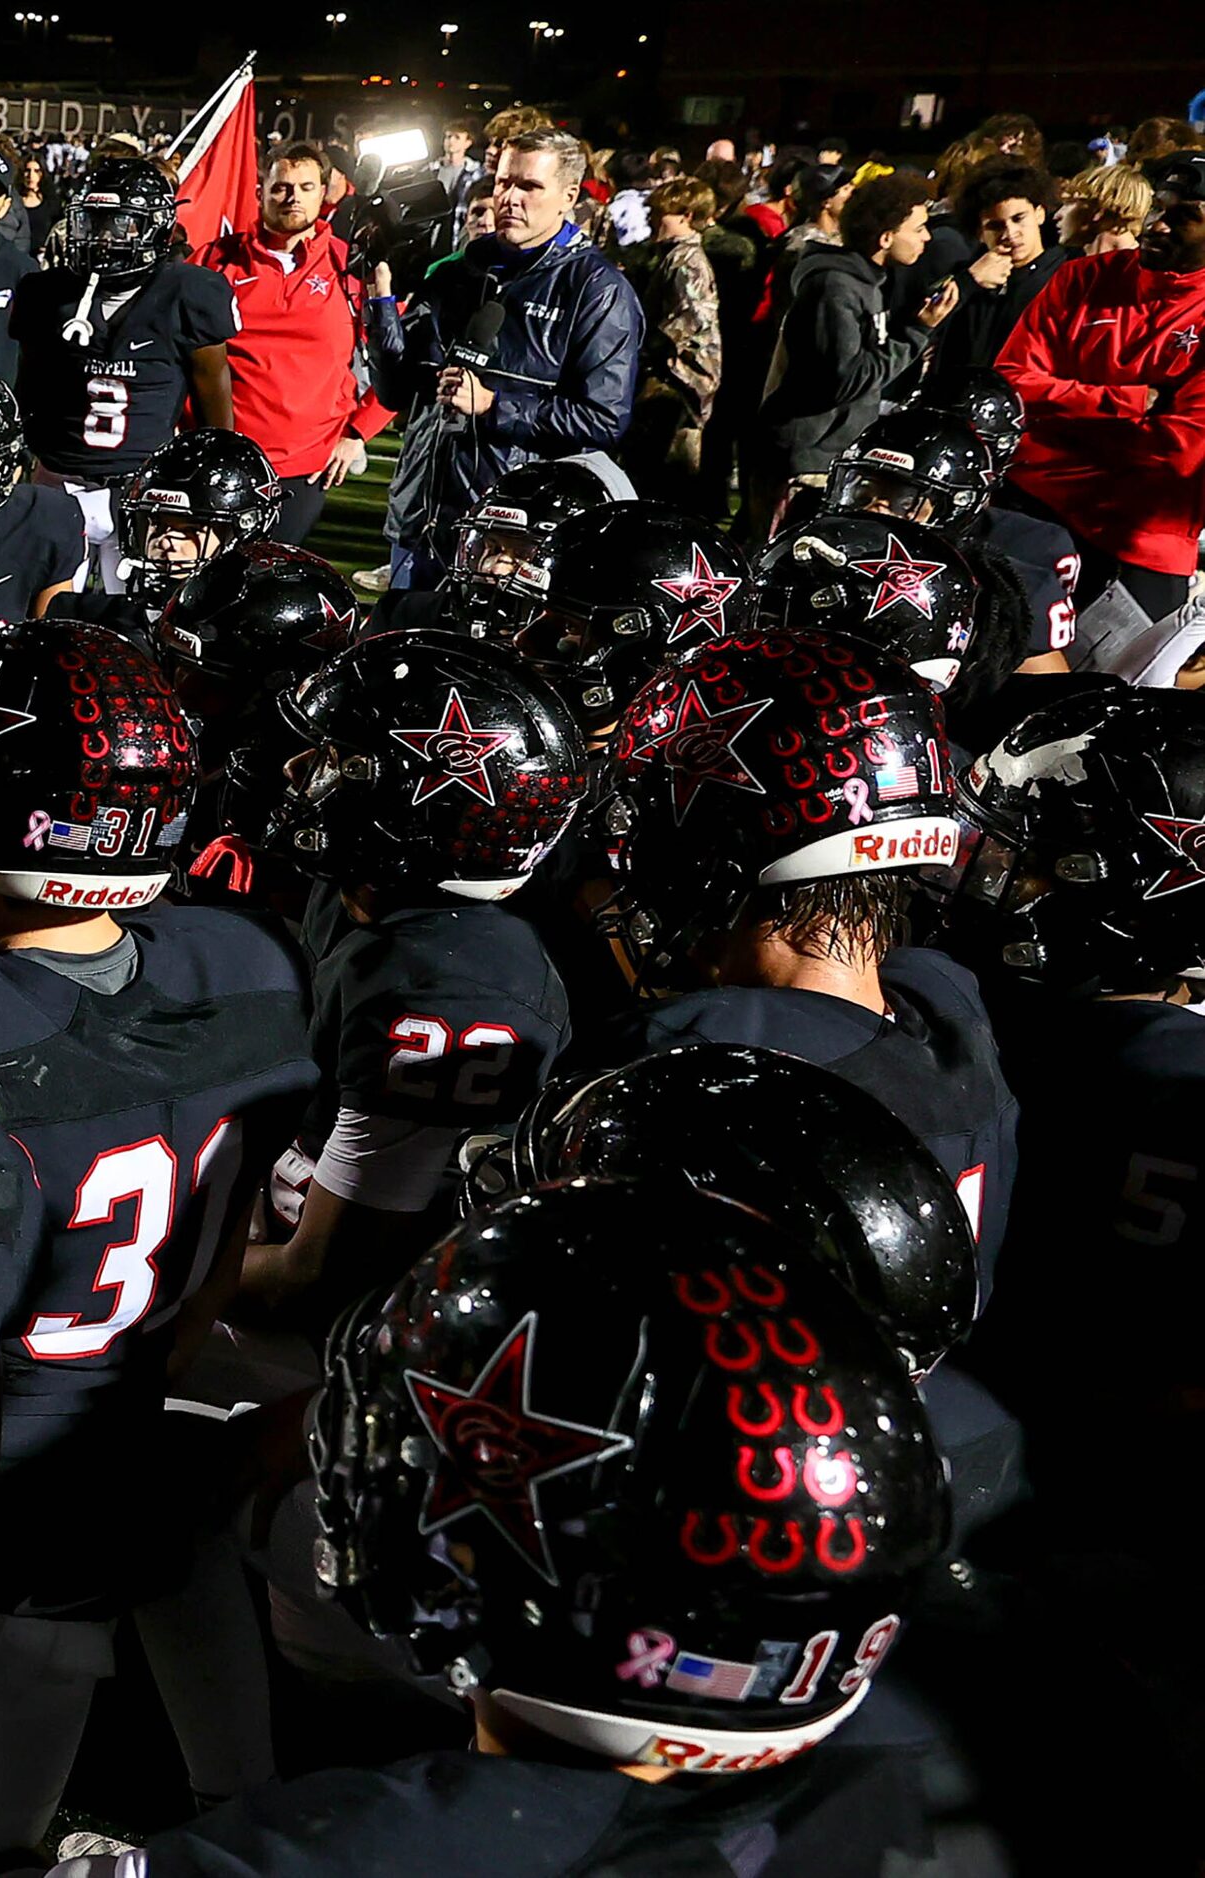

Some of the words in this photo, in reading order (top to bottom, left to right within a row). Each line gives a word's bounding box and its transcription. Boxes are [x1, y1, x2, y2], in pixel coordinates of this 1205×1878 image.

[83, 376, 130, 450] 8
[95, 806, 156, 857] 31
[43, 878, 162, 906] Riddell
[383, 1012, 521, 1107] 22
[779, 1613, 900, 1704] 19
